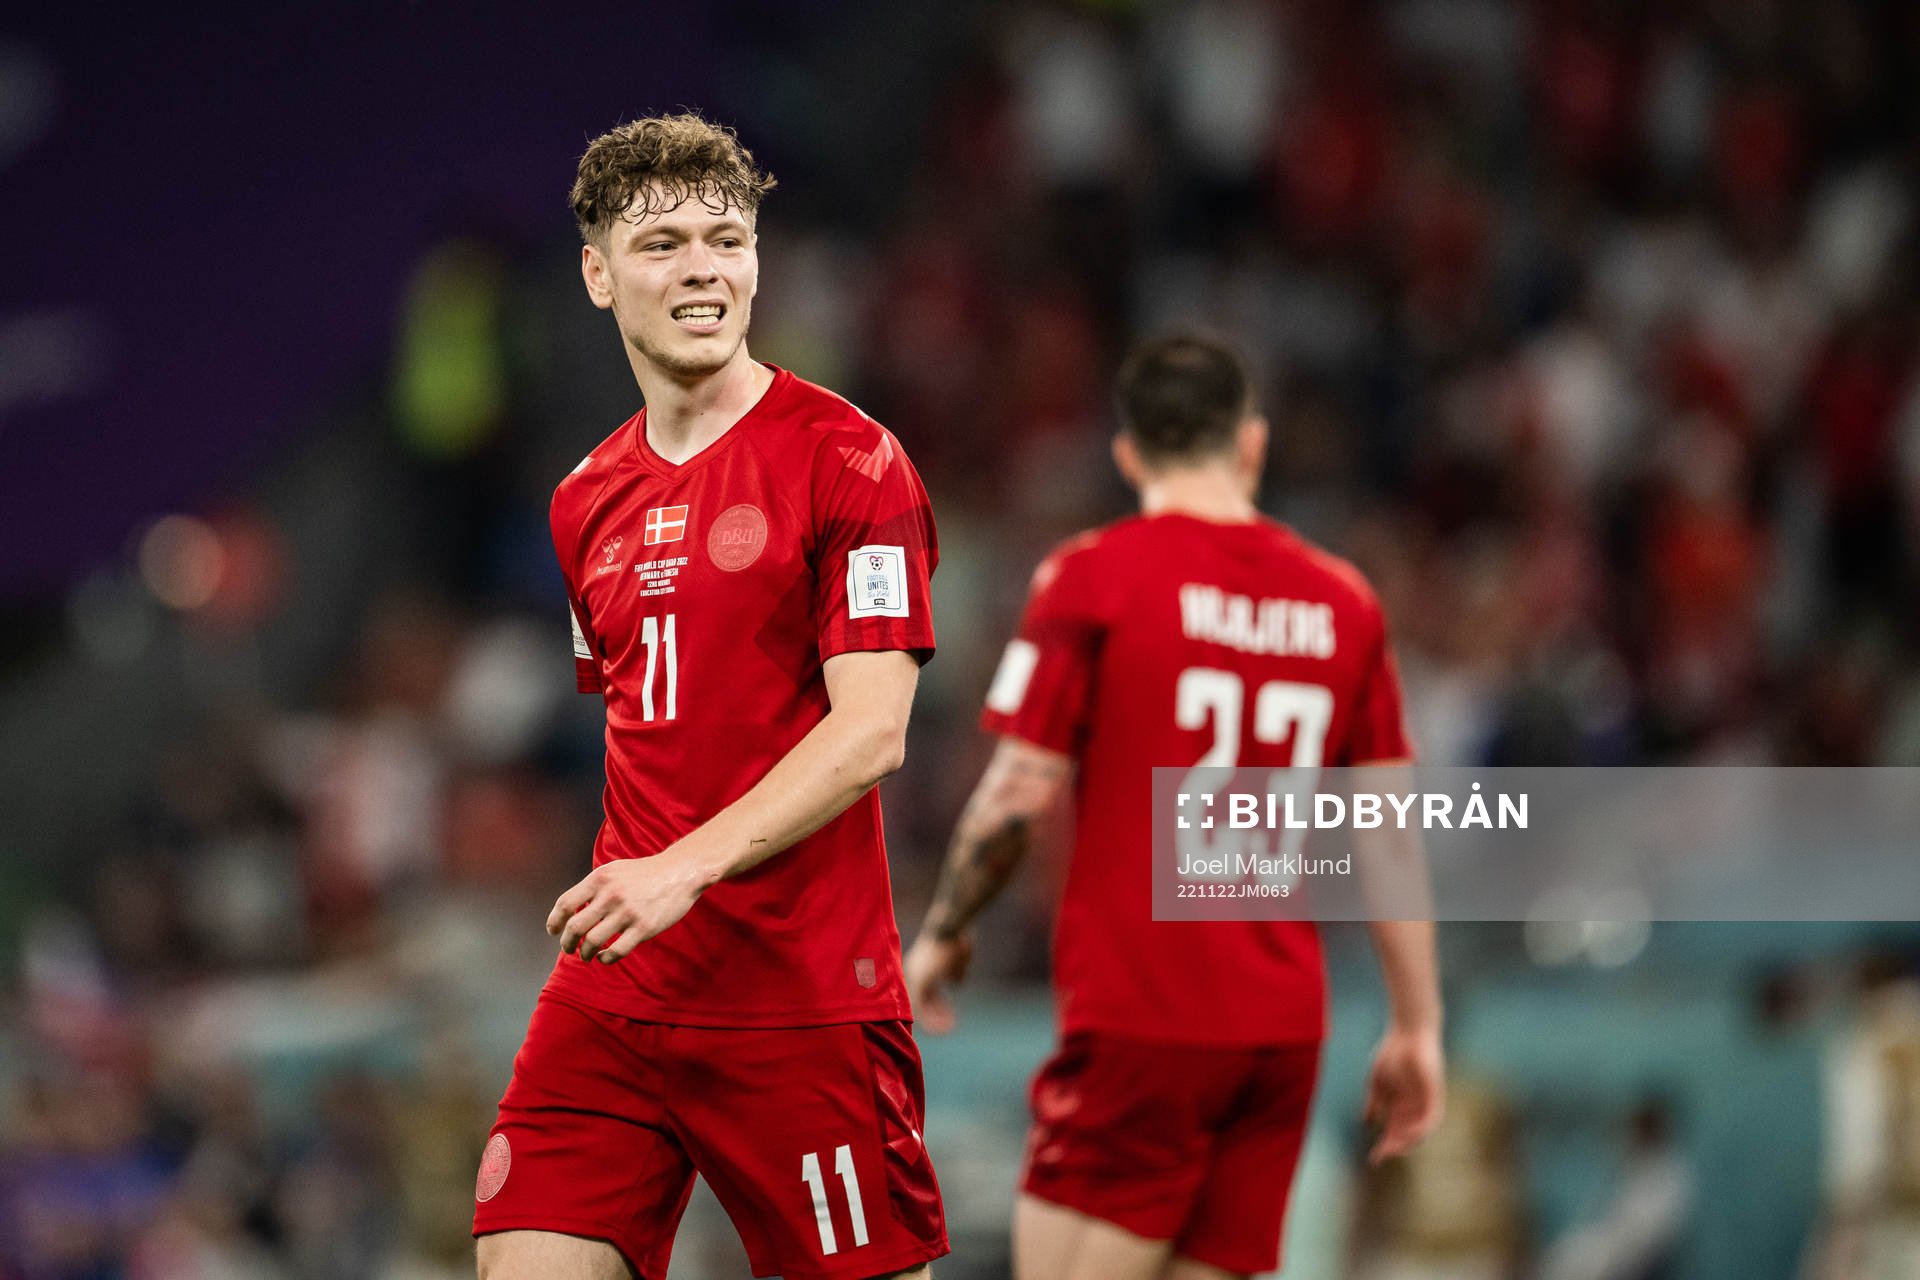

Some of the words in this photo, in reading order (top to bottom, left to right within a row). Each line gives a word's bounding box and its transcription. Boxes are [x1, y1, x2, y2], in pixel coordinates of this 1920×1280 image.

[596, 560, 622, 576] hummel
[867, 580, 889, 591] UNITES
[641, 613, 678, 722] 11
[1174, 666, 1335, 895] 23
[802, 1144, 870, 1256] 11
